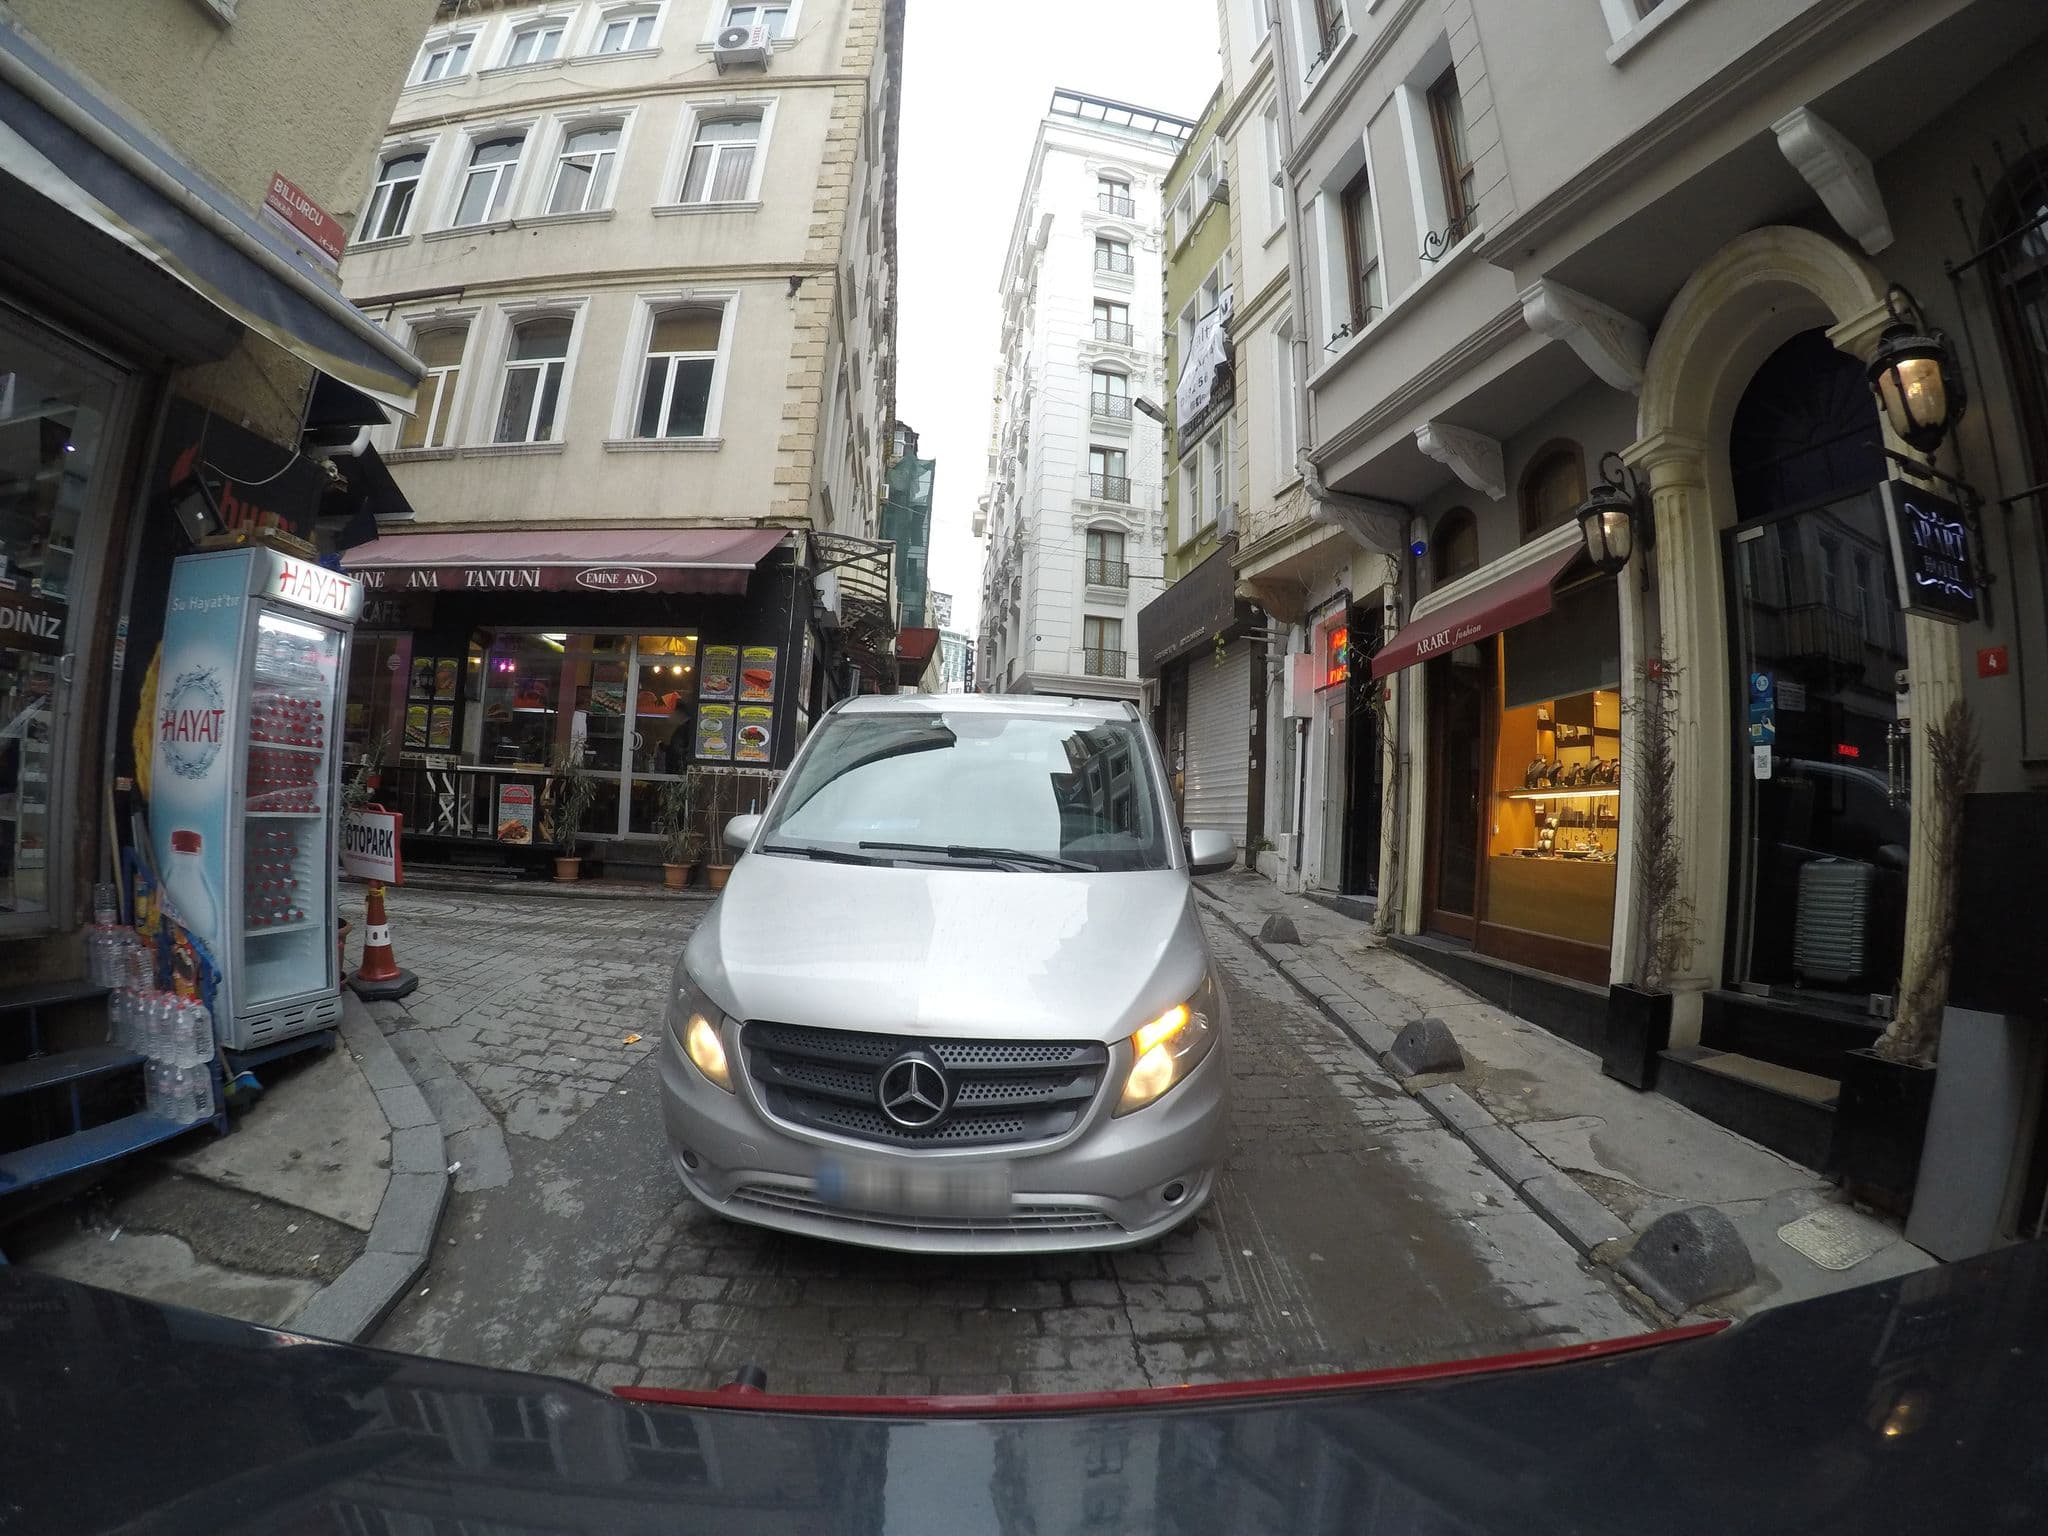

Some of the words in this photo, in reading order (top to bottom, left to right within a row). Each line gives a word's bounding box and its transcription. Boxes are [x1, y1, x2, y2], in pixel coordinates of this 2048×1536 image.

[279, 560, 352, 611] HAYAT
[405, 570, 438, 588] ANA
[465, 568, 541, 588] TANTUNİ
[586, 571, 619, 584] EMİNE
[624, 573, 645, 584] ANA
[0, 606, 62, 640] DİNİZ
[1416, 629, 1451, 656] ARART
[161, 709, 225, 743] HAYAT
[346, 823, 393, 858] OTOPARK
